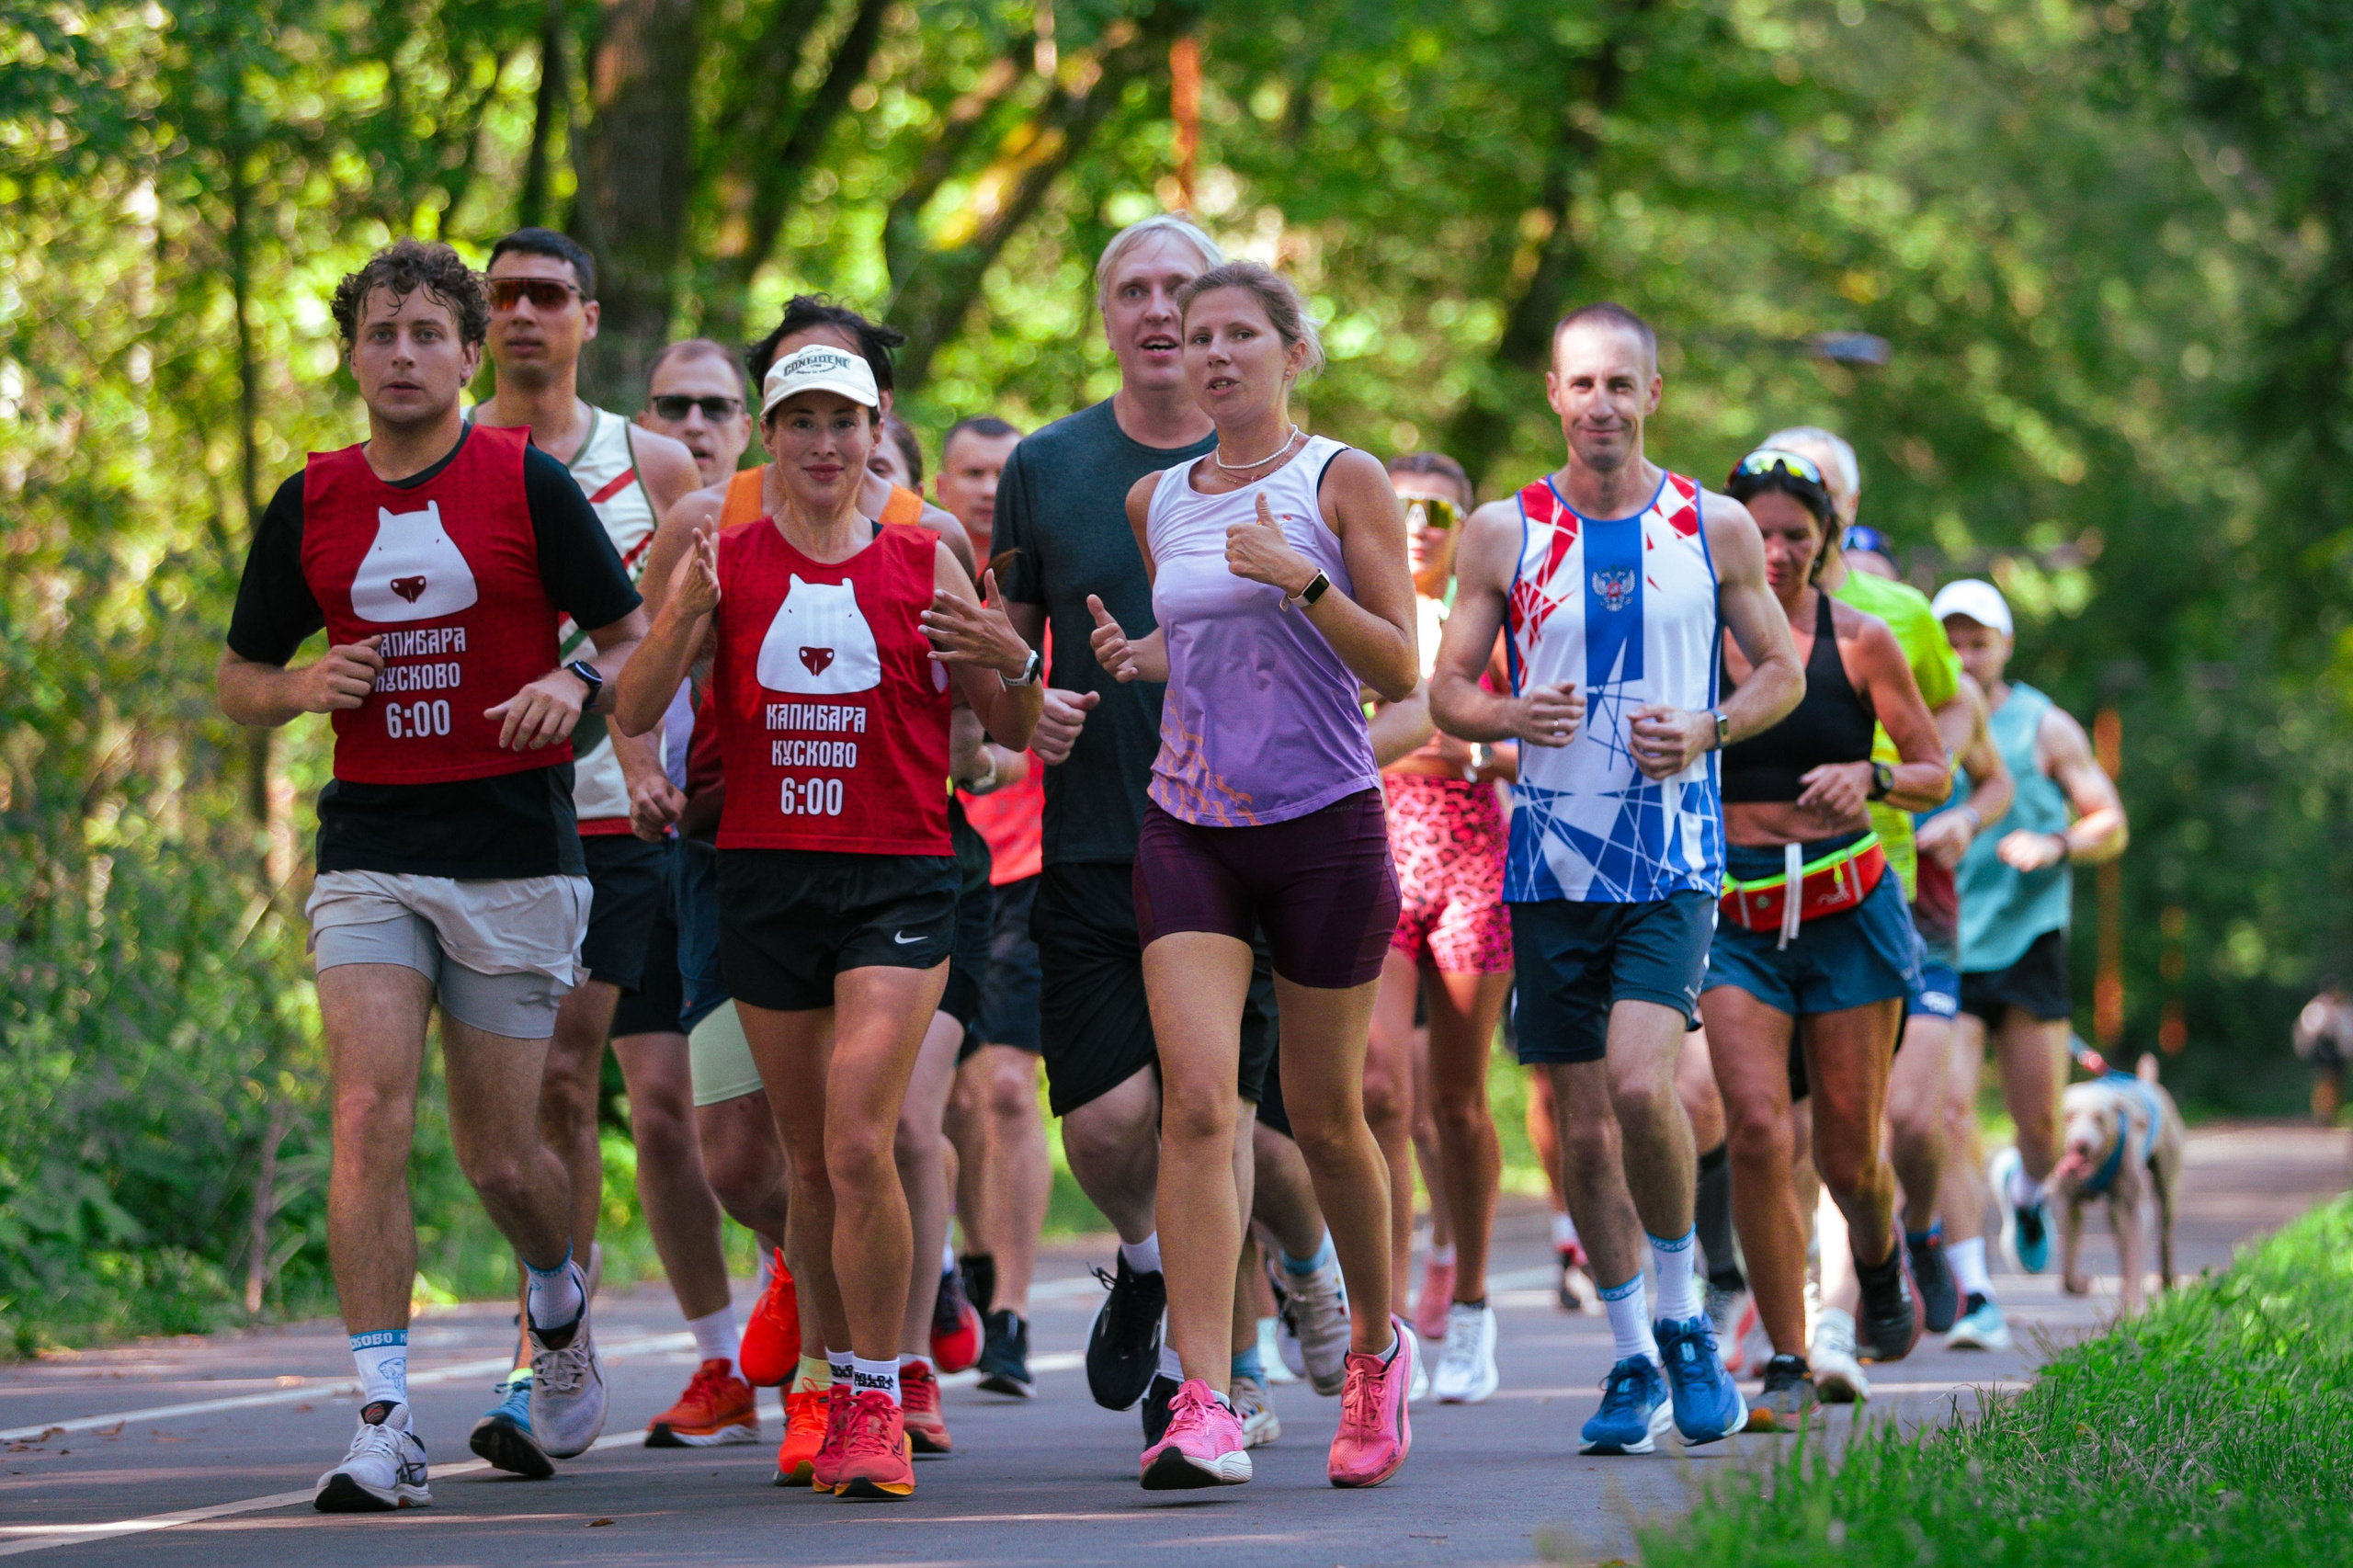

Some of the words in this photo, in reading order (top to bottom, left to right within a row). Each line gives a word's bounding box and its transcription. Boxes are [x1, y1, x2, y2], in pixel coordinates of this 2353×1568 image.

[377, 627, 467, 658] АПИБАРА
[386, 699, 451, 739] 6:00
[766, 703, 867, 733] КАПИБАРА
[771, 739, 858, 768] КУСКОВО
[780, 777, 844, 816] 6:00
